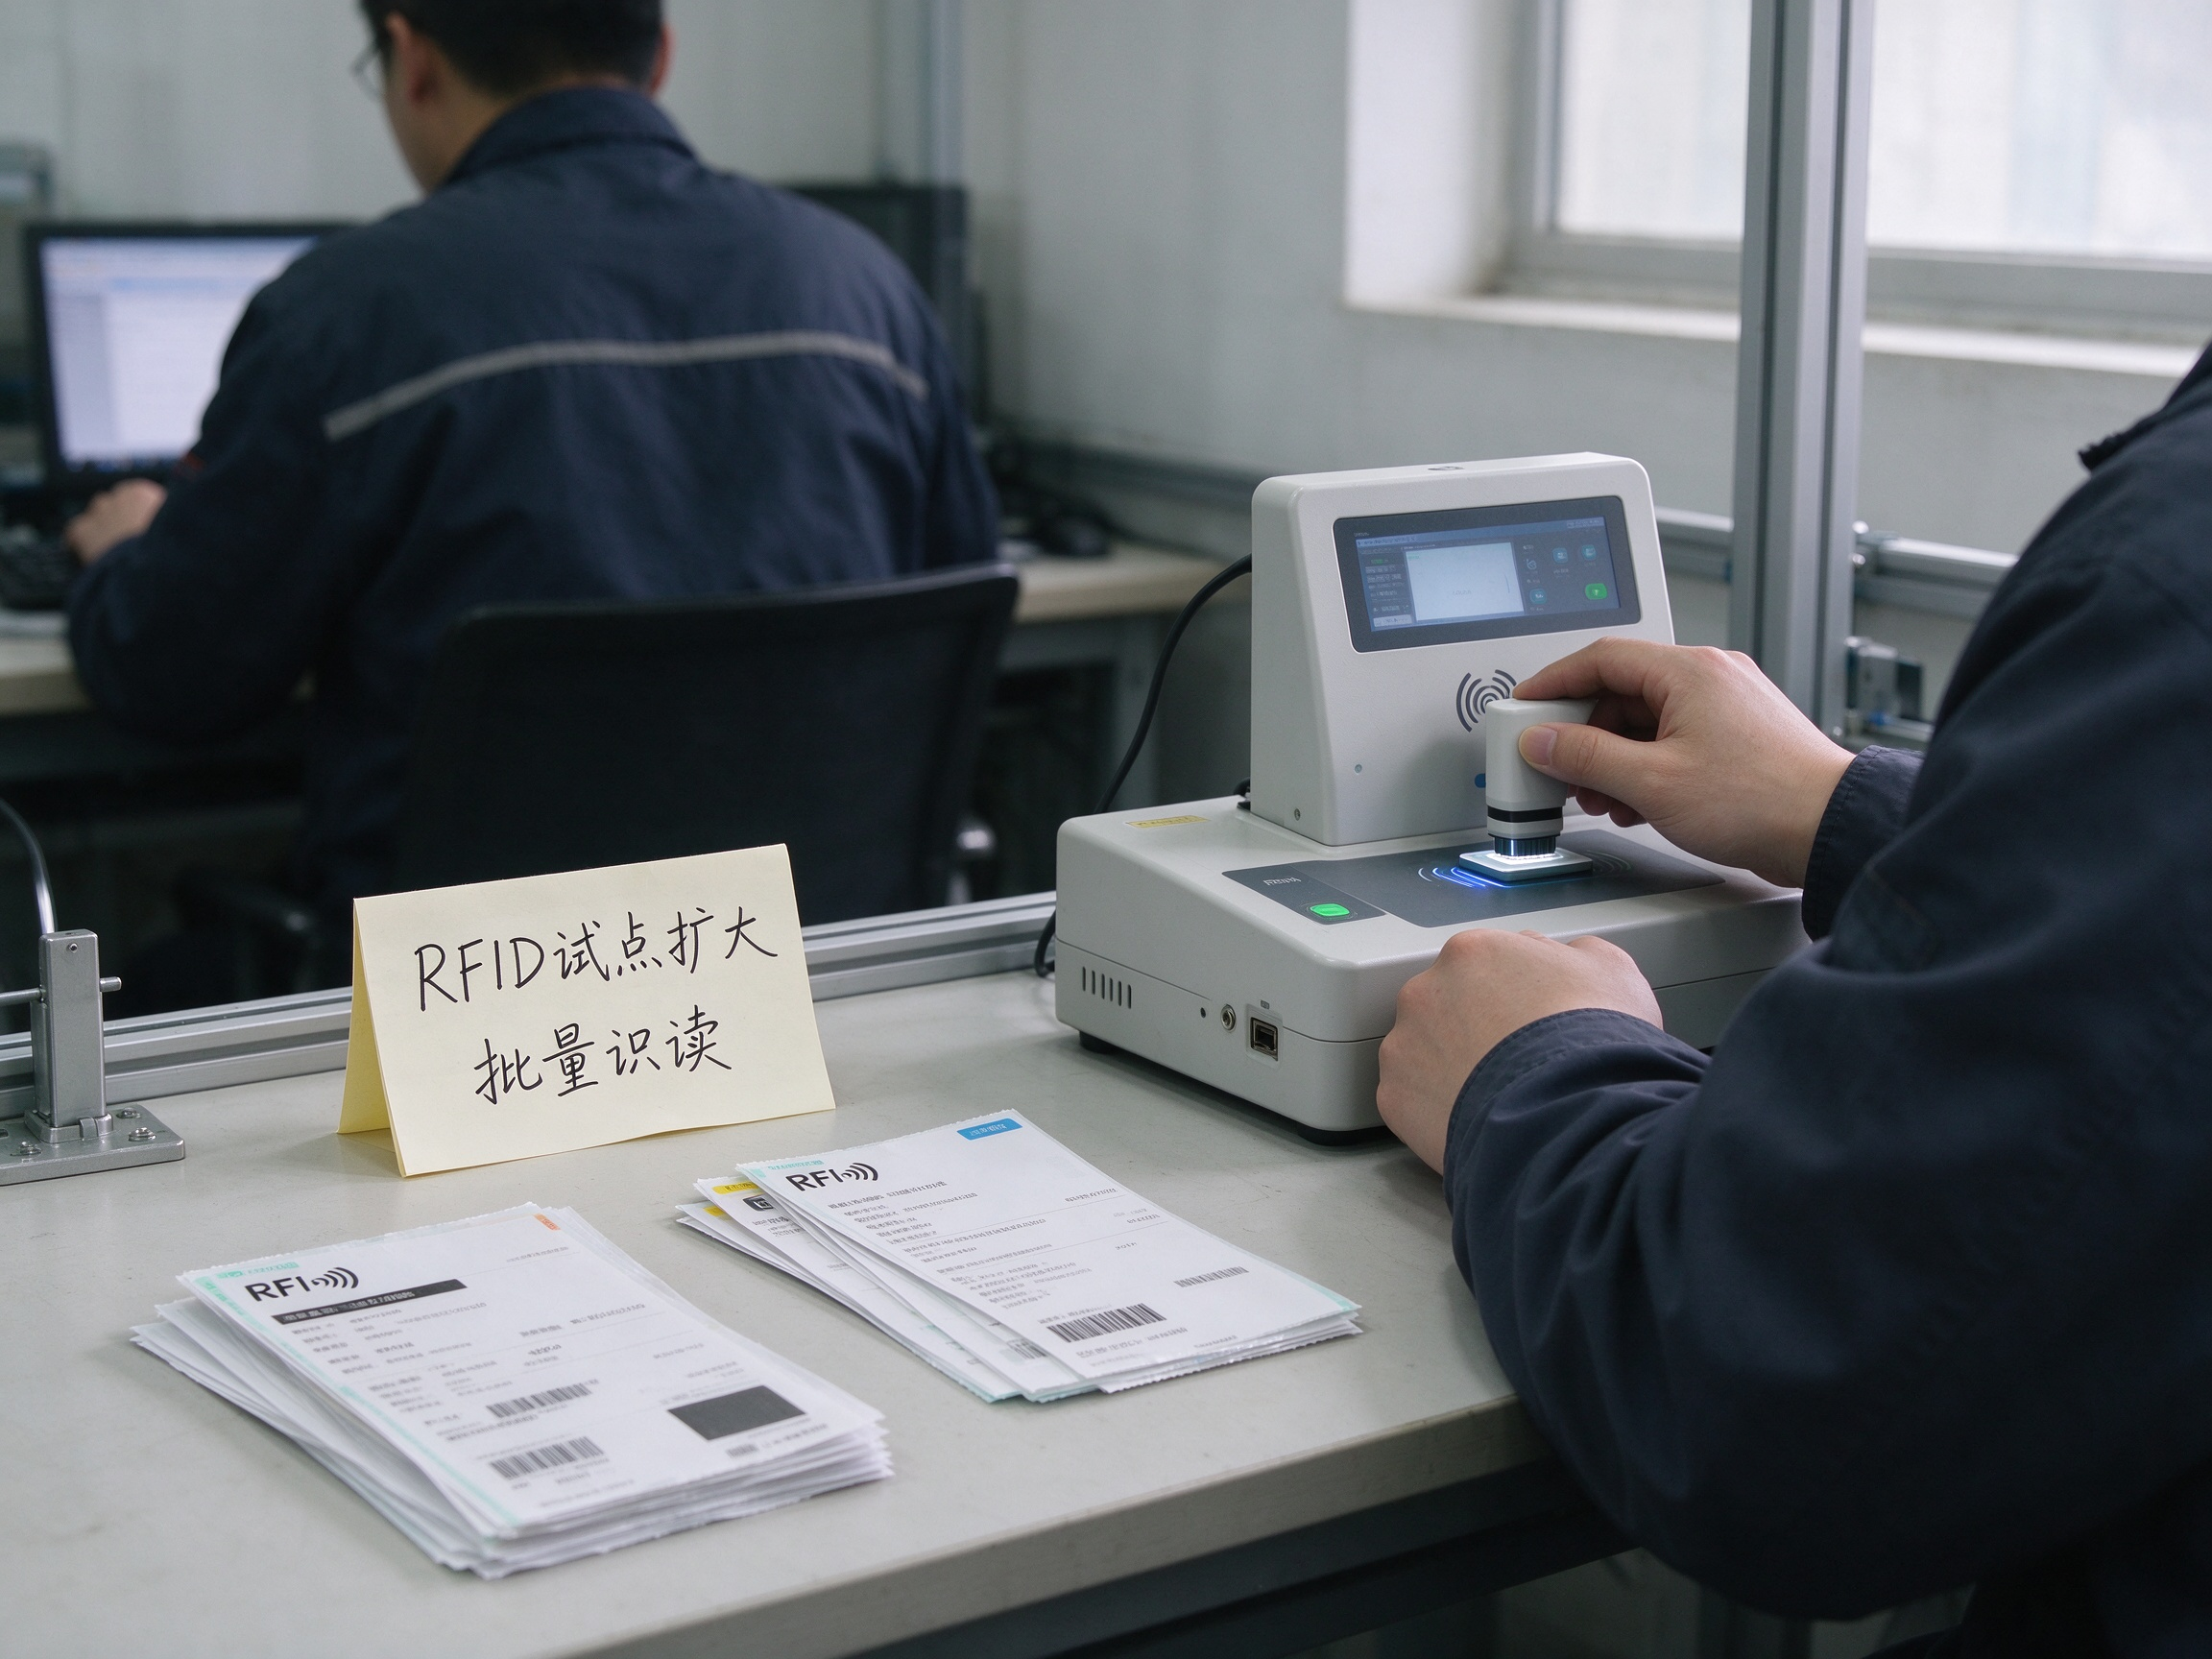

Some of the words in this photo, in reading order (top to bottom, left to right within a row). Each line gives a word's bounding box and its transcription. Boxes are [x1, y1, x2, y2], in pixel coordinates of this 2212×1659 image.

[414, 905, 779, 1012] RFID试点扩大
[473, 1004, 733, 1105] 批量识读
